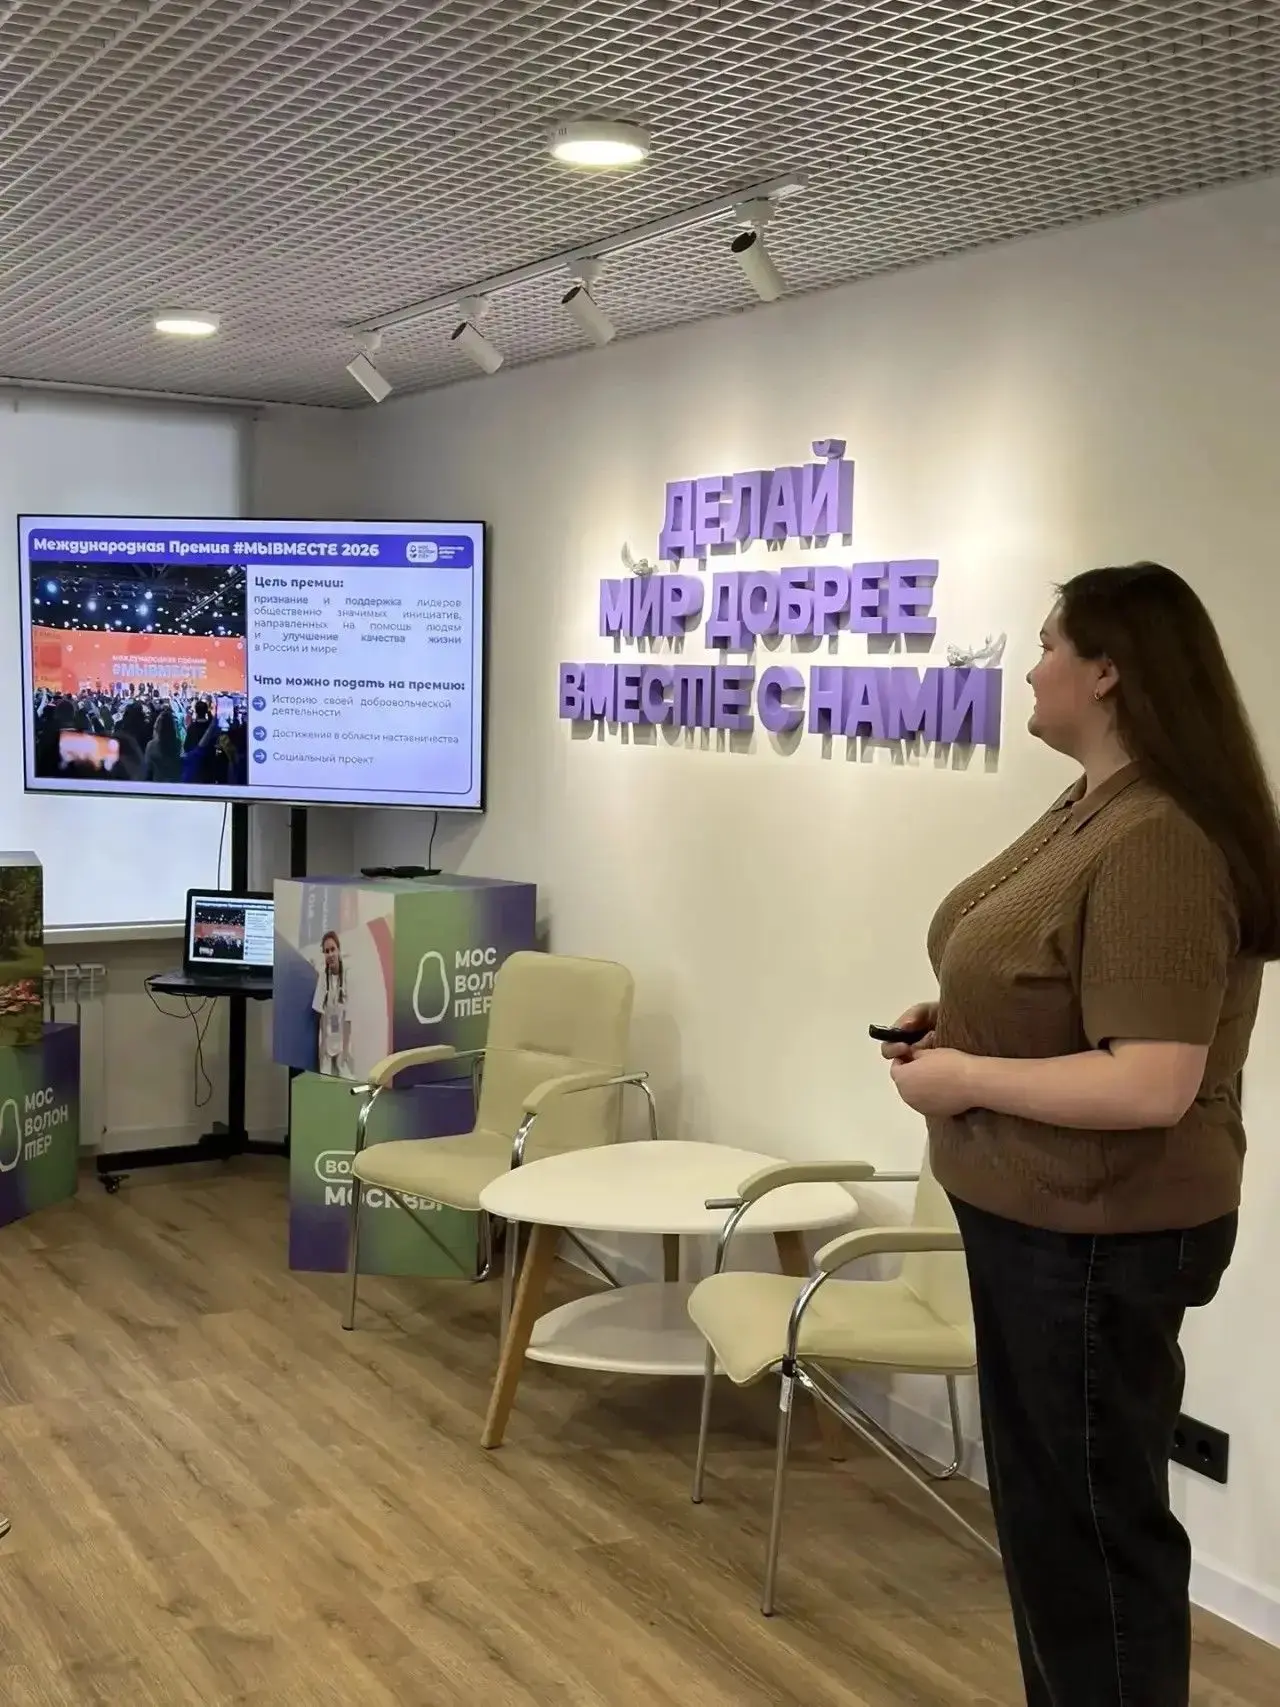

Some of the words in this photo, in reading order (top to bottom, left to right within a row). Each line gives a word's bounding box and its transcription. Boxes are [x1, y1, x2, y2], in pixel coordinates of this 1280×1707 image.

[659, 439, 855, 561] ДЕЛАЙ
[33, 538, 165, 555] Международная
[169, 540, 230, 556] Премия
[233, 541, 338, 557] #МЫВМЕСТЕ
[342, 543, 380, 557] 2026
[255, 576, 288, 589] Цель
[291, 578, 344, 590] премии:
[254, 596, 309, 606] признание
[345, 597, 402, 607] поддержка
[416, 600, 462, 609] лидеров
[599, 573, 704, 637] МИР
[705, 559, 939, 650] ДОБРЕЕ
[254, 606, 322, 618] общественно
[338, 609, 387, 618] значимых
[254, 620, 328, 630] направленных
[343, 622, 355, 630] на
[370, 623, 412, 632] помощь
[426, 624, 462, 632] людям
[282, 633, 339, 642] улучшение
[361, 635, 406, 643] качества
[427, 636, 462, 645] жизни
[263, 643, 300, 653] России
[302, 645, 309, 653] и
[310, 646, 338, 655] мире
[254, 675, 282, 686] Что
[286, 678, 330, 687] можно
[333, 678, 385, 690] подать
[389, 680, 405, 689] на
[409, 680, 465, 692] премию:
[272, 694, 318, 706] Историю
[324, 696, 354, 706] своей
[360, 697, 452, 709] добровольческой
[559, 662, 755, 730] ВМЕСТЕ
[758, 665, 806, 732] С
[808, 666, 1003, 745] НАМИ
[272, 707, 341, 718] деятельности
[272, 730, 332, 739] Достижения
[334, 732, 340, 740] в
[342, 731, 381, 742] области
[382, 734, 459, 744] наставничества
[272, 752, 336, 763] Социальный
[338, 755, 374, 766] проект
[455, 947, 497, 969] МОС
[455, 971, 497, 993] ВОЛ
[25, 1087, 54, 1113] МОС
[24, 1104, 69, 1137] ВОЛОН
